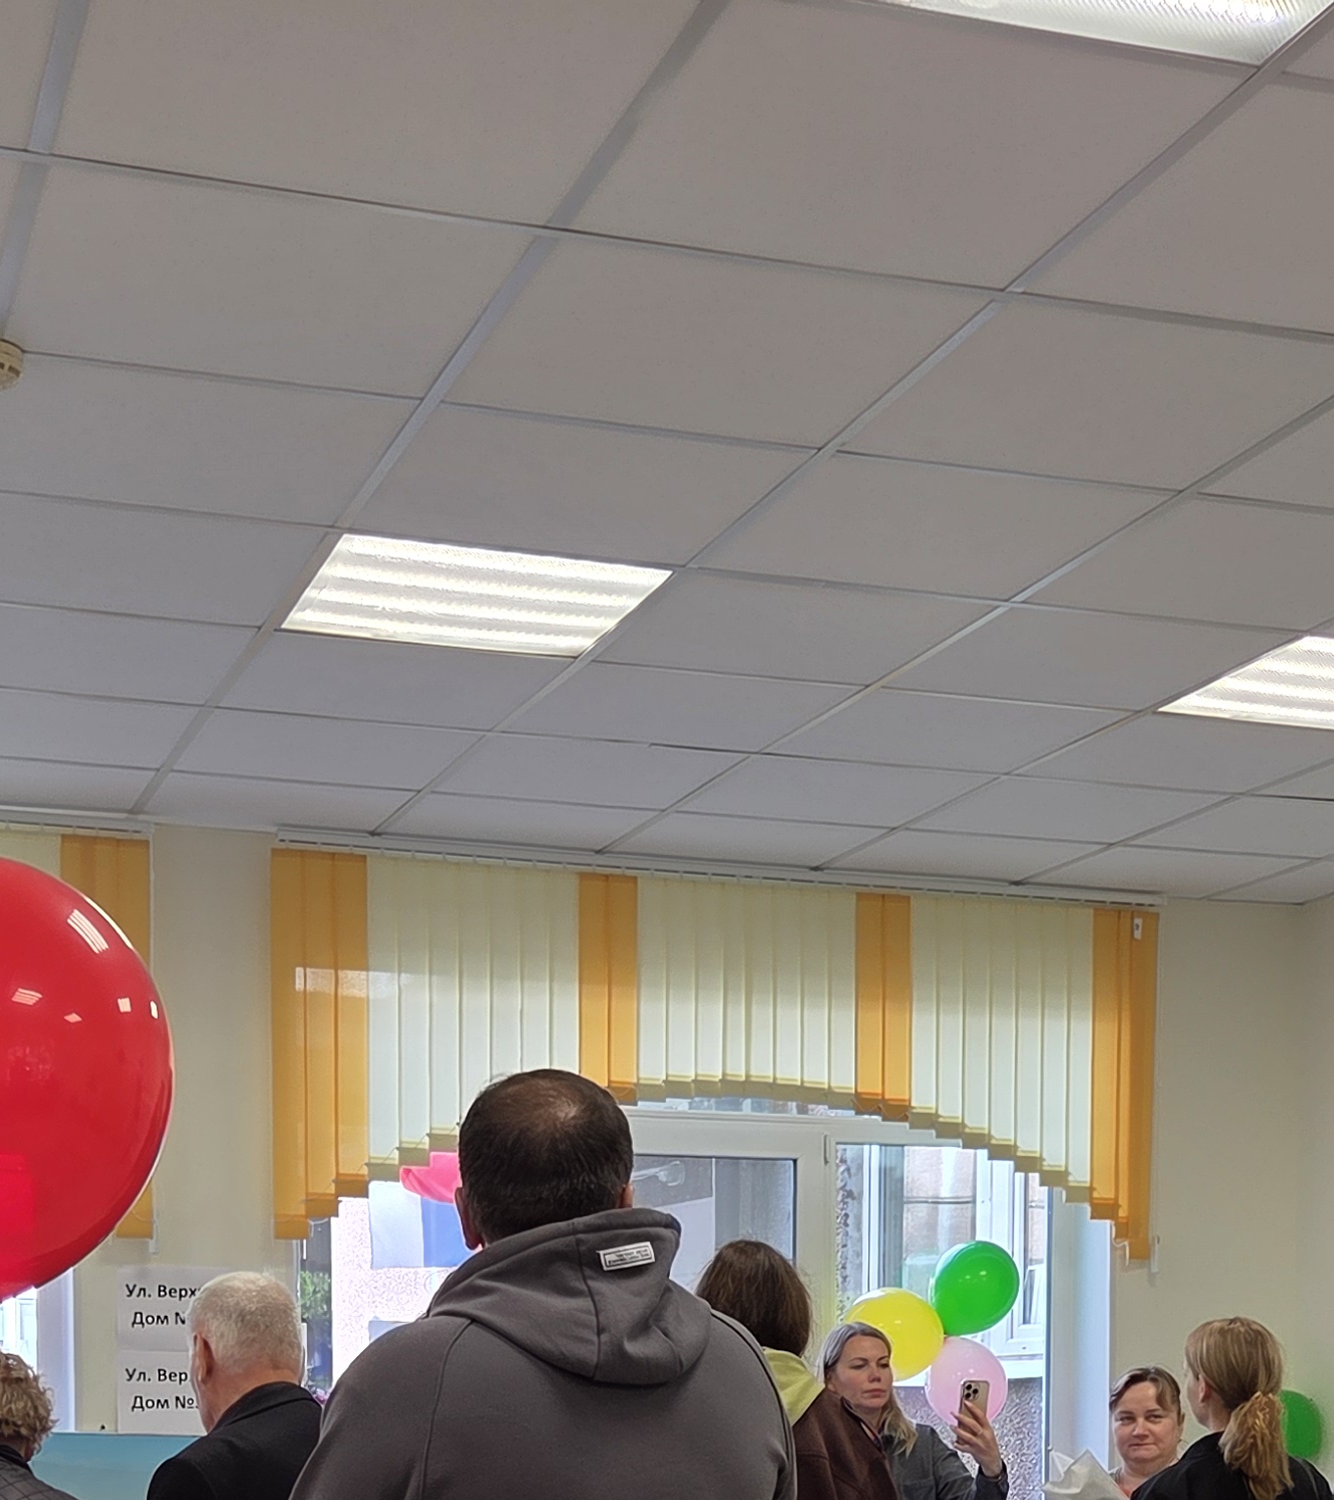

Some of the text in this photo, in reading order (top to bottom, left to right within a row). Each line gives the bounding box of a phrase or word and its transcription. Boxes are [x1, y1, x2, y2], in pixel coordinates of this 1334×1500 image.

[125, 1283, 202, 1301] Ул. Верх
[131, 1311, 169, 1329] Дом
[125, 1367, 192, 1385] Ул. Вер
[131, 1395, 170, 1412] Дом
